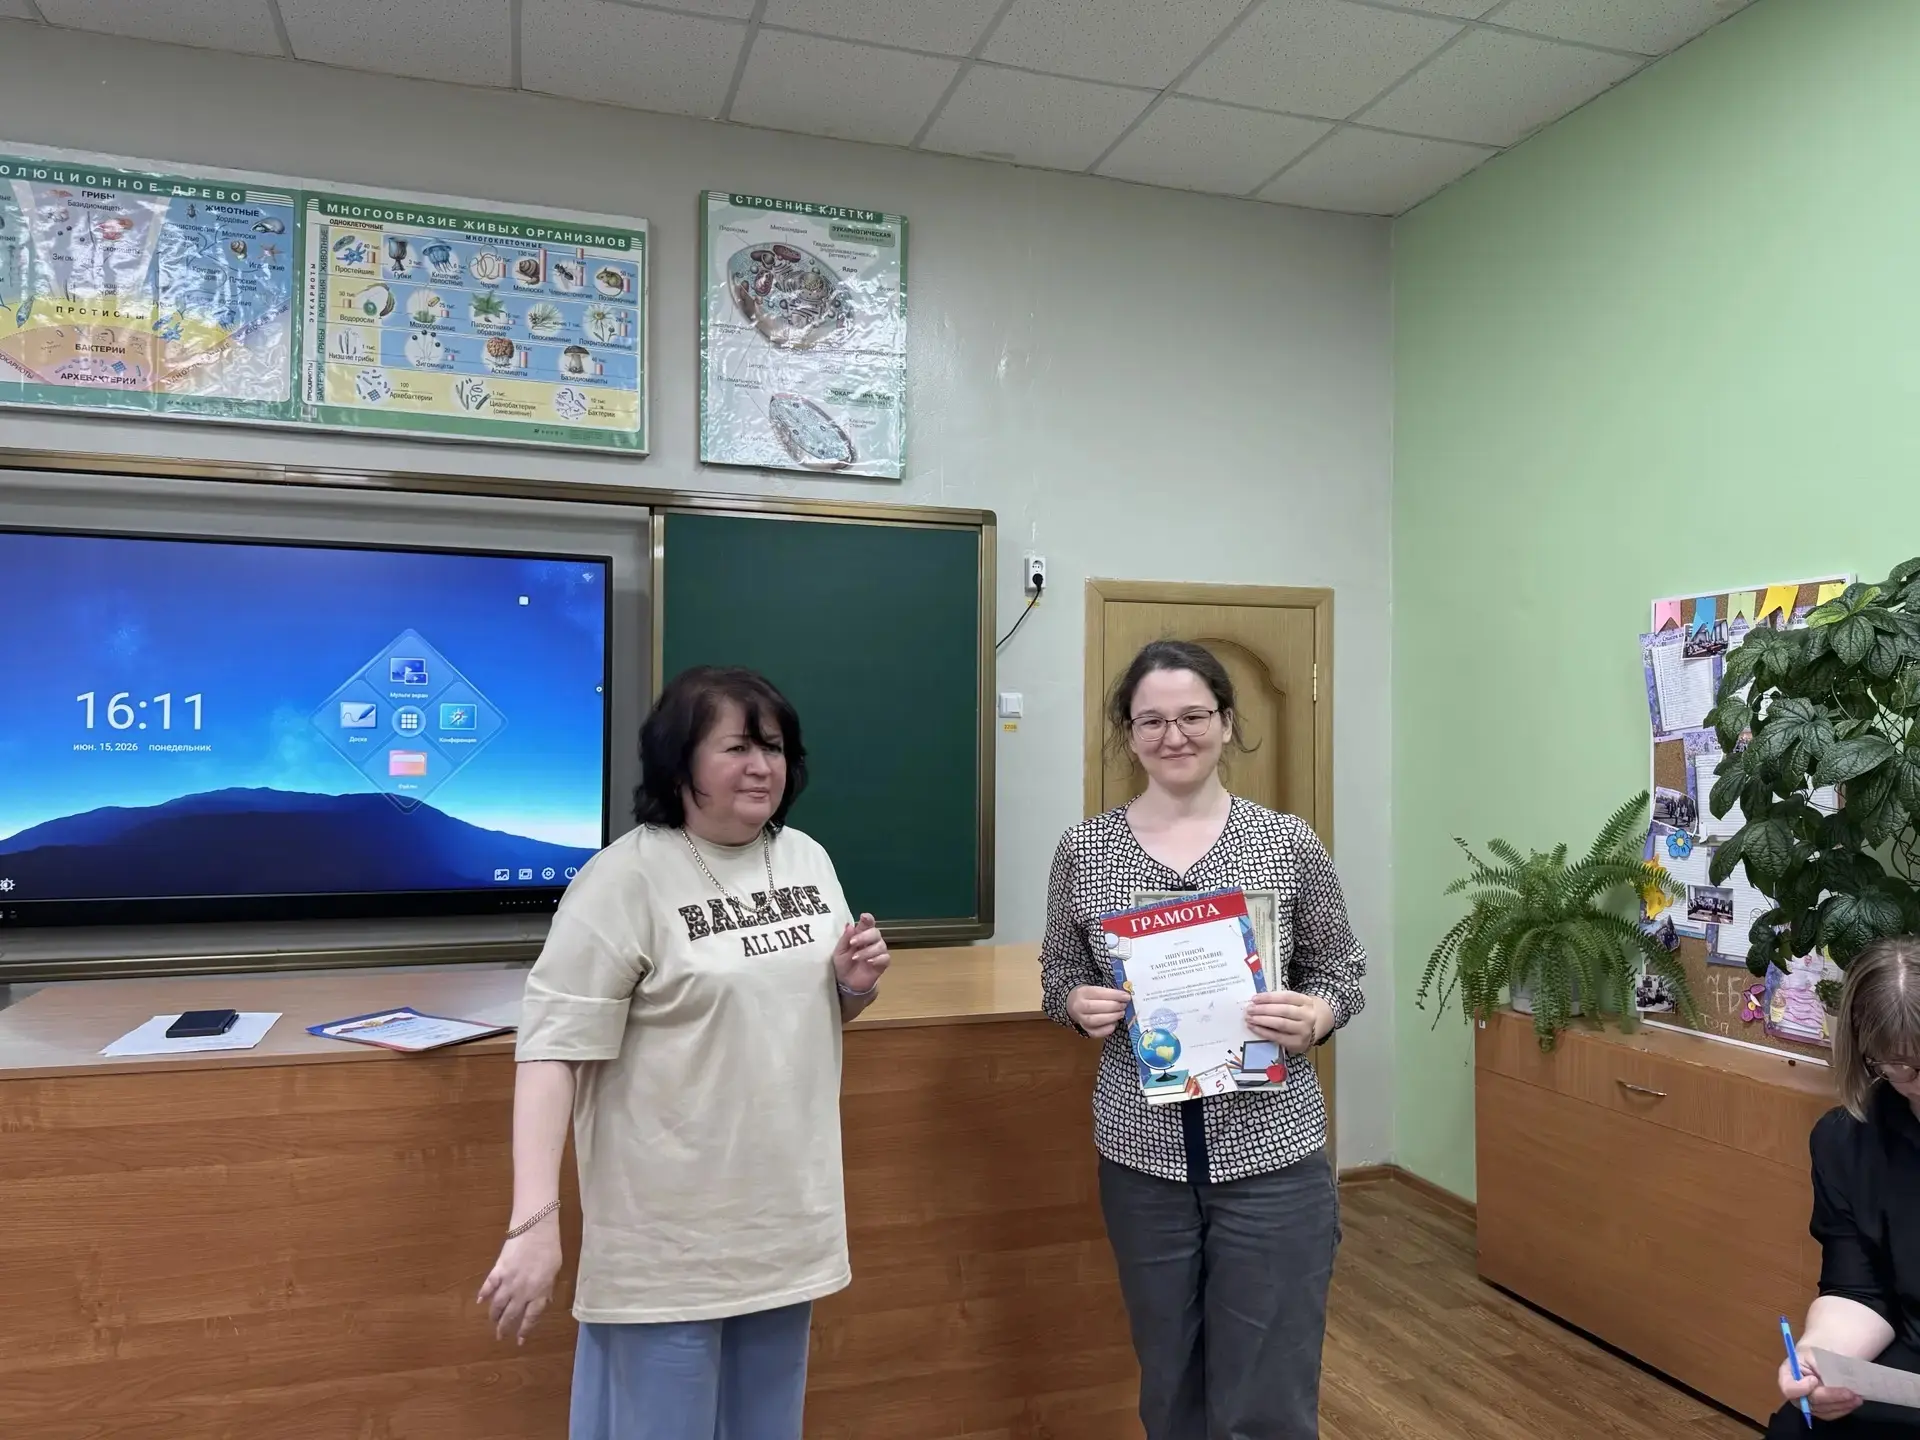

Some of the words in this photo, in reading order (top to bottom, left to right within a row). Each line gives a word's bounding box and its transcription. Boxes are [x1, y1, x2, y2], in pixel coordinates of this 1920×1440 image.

[81, 190, 115, 199] ГРИБЫ
[171, 185, 241, 201] ДРЕВО
[205, 204, 260, 217] ЖИВОТНЫЕ
[735, 195, 812, 213] СТРОЕНИЕ
[819, 205, 874, 220] КЛЕТКИ
[327, 203, 457, 228] МНОГООБРАЗИЕ
[463, 220, 520, 235] ЖИВЫХ
[525, 228, 626, 247] ОРГАНИЗМОВ
[329, 218, 384, 230] ОДНОКЛЕТОЧНЫЕ
[832, 225, 892, 238] ЭУКАРИОТИЧЕСКАЯ
[465, 234, 543, 249] МНОГОКЛЕТОЧНЫЕ
[319, 229, 329, 272] ЖИВОТНЫЕ
[335, 265, 374, 276] Простейшие
[393, 271, 412, 280] Губки
[308, 263, 316, 323] ЭУКАРИОТЫ
[318, 279, 327, 318] РАСТЕНИЯ
[339, 313, 375, 324] Водоросли
[409, 320, 456, 332] Мохообразные
[317, 328, 326, 354] ГРИБЫ
[75, 343, 126, 354] БАКТЕРИИ
[353, 355, 375, 363] грибы
[60, 372, 137, 385] АРХЕБАКТЕРИИ
[306, 362, 314, 401] ПРОКАРИОТЫ
[389, 391, 433, 401] Архебактерии
[489, 401, 536, 410] Цианобактерии
[587, 408, 616, 418] Бактерии
[77, 691, 202, 730] 16:11
[73, 743, 97, 751] июн.
[100, 743, 113, 752] 15,
[115, 743, 138, 751] 2026
[149, 743, 212, 753] понедельник
[678, 885, 831, 942] BALANCE
[1130, 902, 1221, 933] ГРАМОТА
[741, 931, 778, 957] ALL
[778, 923, 815, 949] DAY
